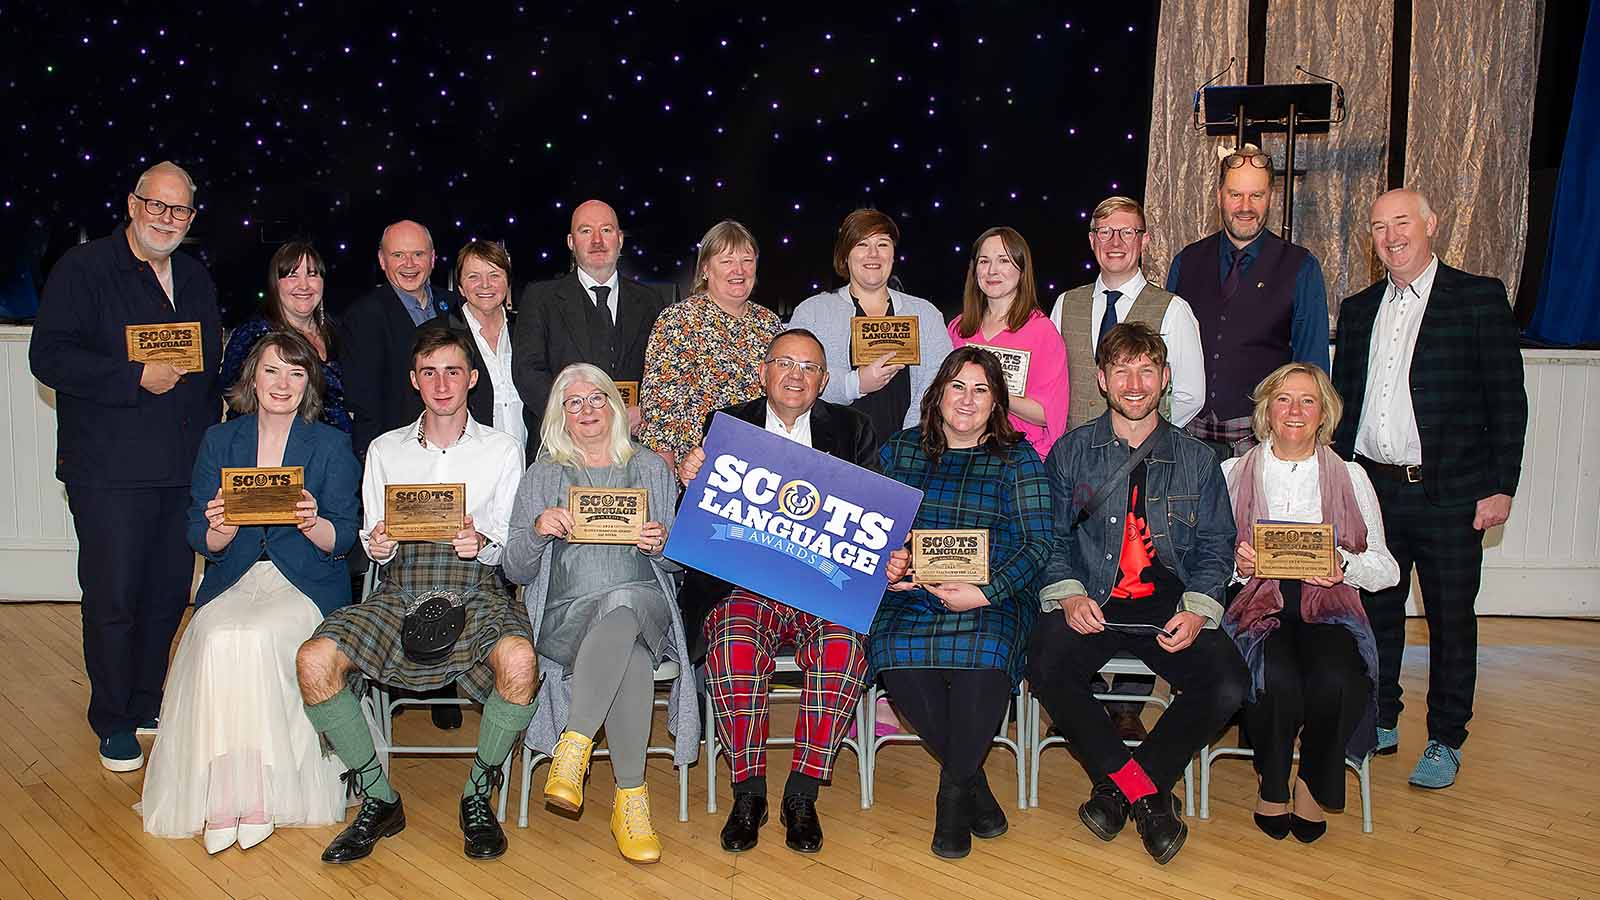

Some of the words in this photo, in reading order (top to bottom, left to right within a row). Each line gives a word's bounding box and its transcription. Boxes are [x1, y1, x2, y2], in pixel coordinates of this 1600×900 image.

[861, 321, 911, 333] SCOTS
[139, 330, 193, 341] SCOTS
[232, 473, 291, 487] SCOTS
[395, 490, 454, 503] SCOTS
[579, 494, 638, 507] SCOTS
[706, 454, 895, 551] SCOTS
[579, 506, 637, 515] LANGUAGE
[698, 488, 881, 576] LANGUAGE
[922, 535, 978, 548] SCOTS
[749, 532, 818, 565] AWARDS
